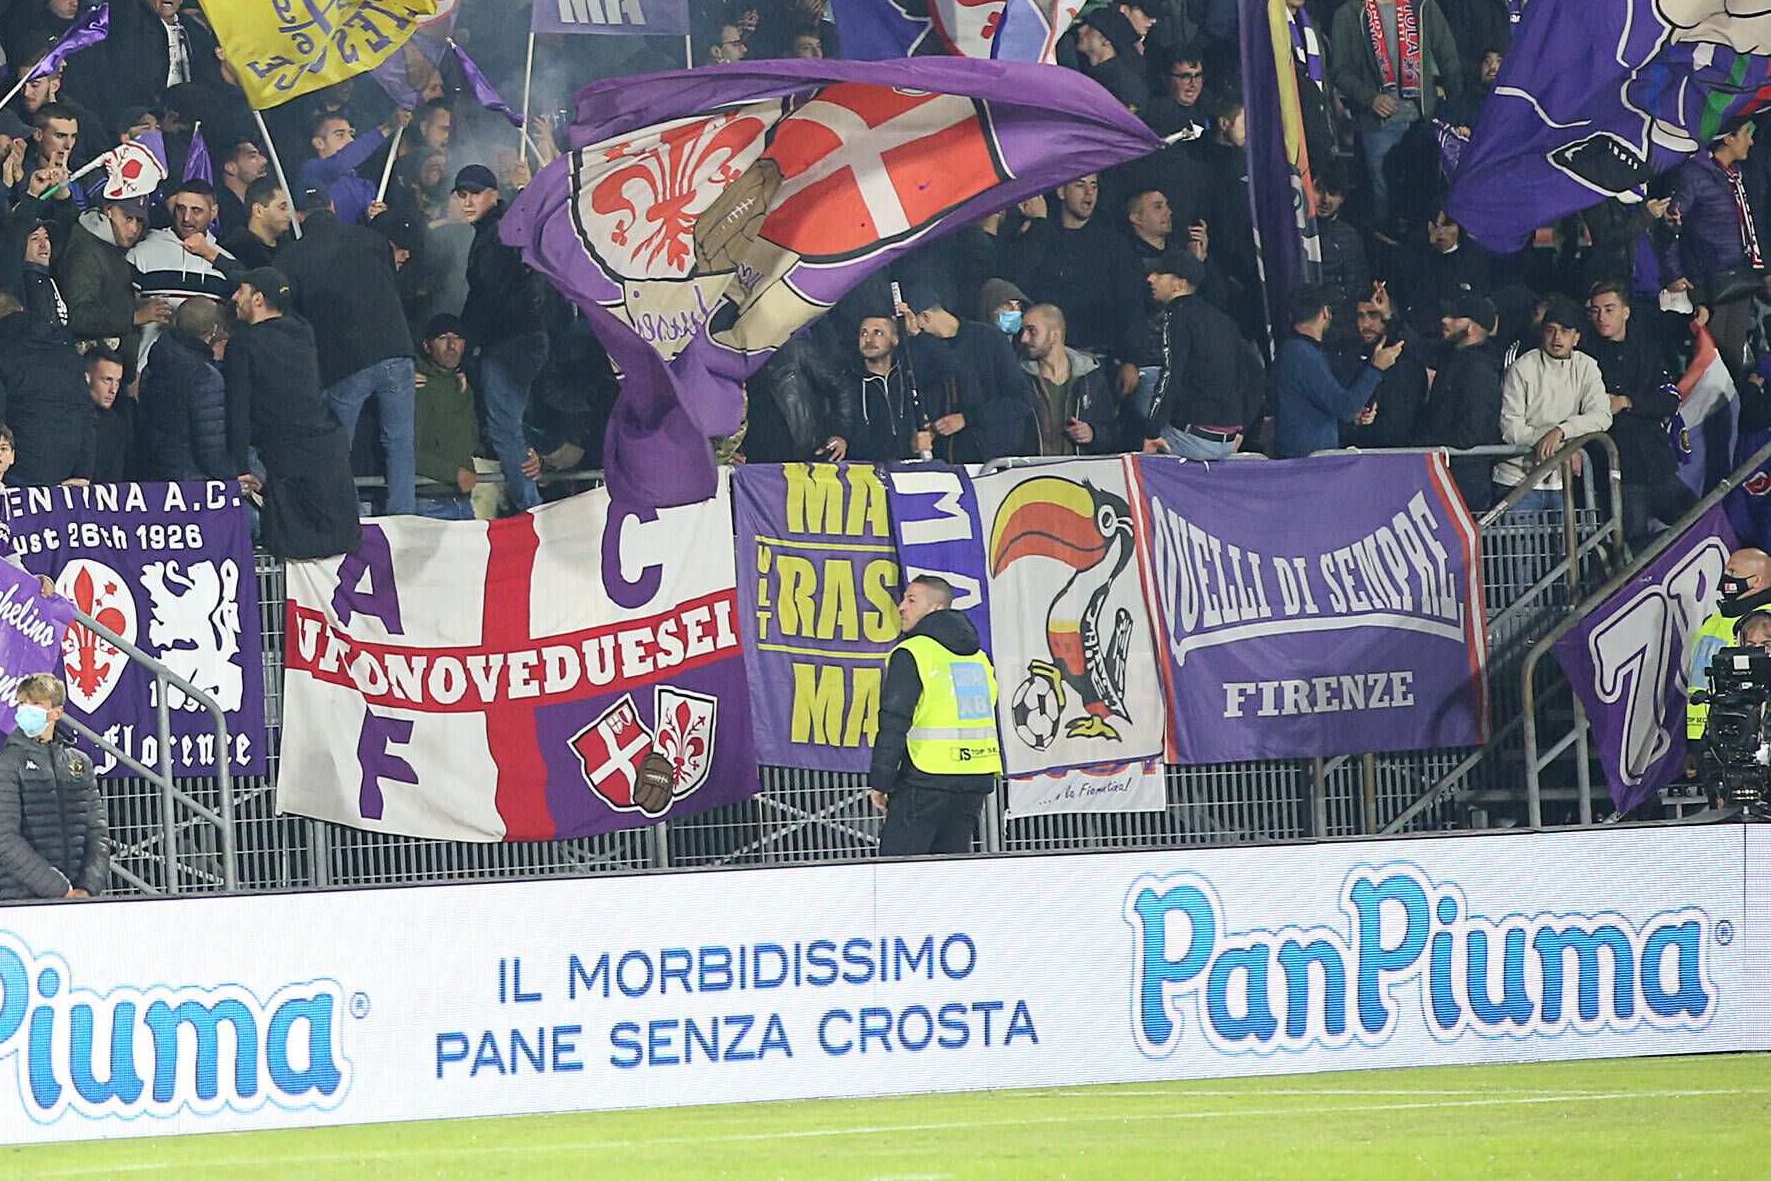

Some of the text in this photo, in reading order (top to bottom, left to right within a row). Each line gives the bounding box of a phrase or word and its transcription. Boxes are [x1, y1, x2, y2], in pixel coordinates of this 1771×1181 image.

[4, 482, 148, 518] ENTINA
[12, 528, 61, 555] ust
[68, 522, 128, 550] 26th
[135, 523, 204, 550] 1926
[331, 522, 405, 635] A
[776, 554, 902, 645] RAS
[1151, 489, 1459, 657] QUELLI DI SEMPRE
[1222, 670, 1415, 719] FIRENZE
[94, 722, 253, 775] Floence
[356, 704, 420, 821] F
[498, 931, 978, 1004] IL MORBIDISSIMO
[1133, 874, 1712, 1046] PanPiuma
[435, 998, 1041, 1079] PANE SENZA CROSTA
